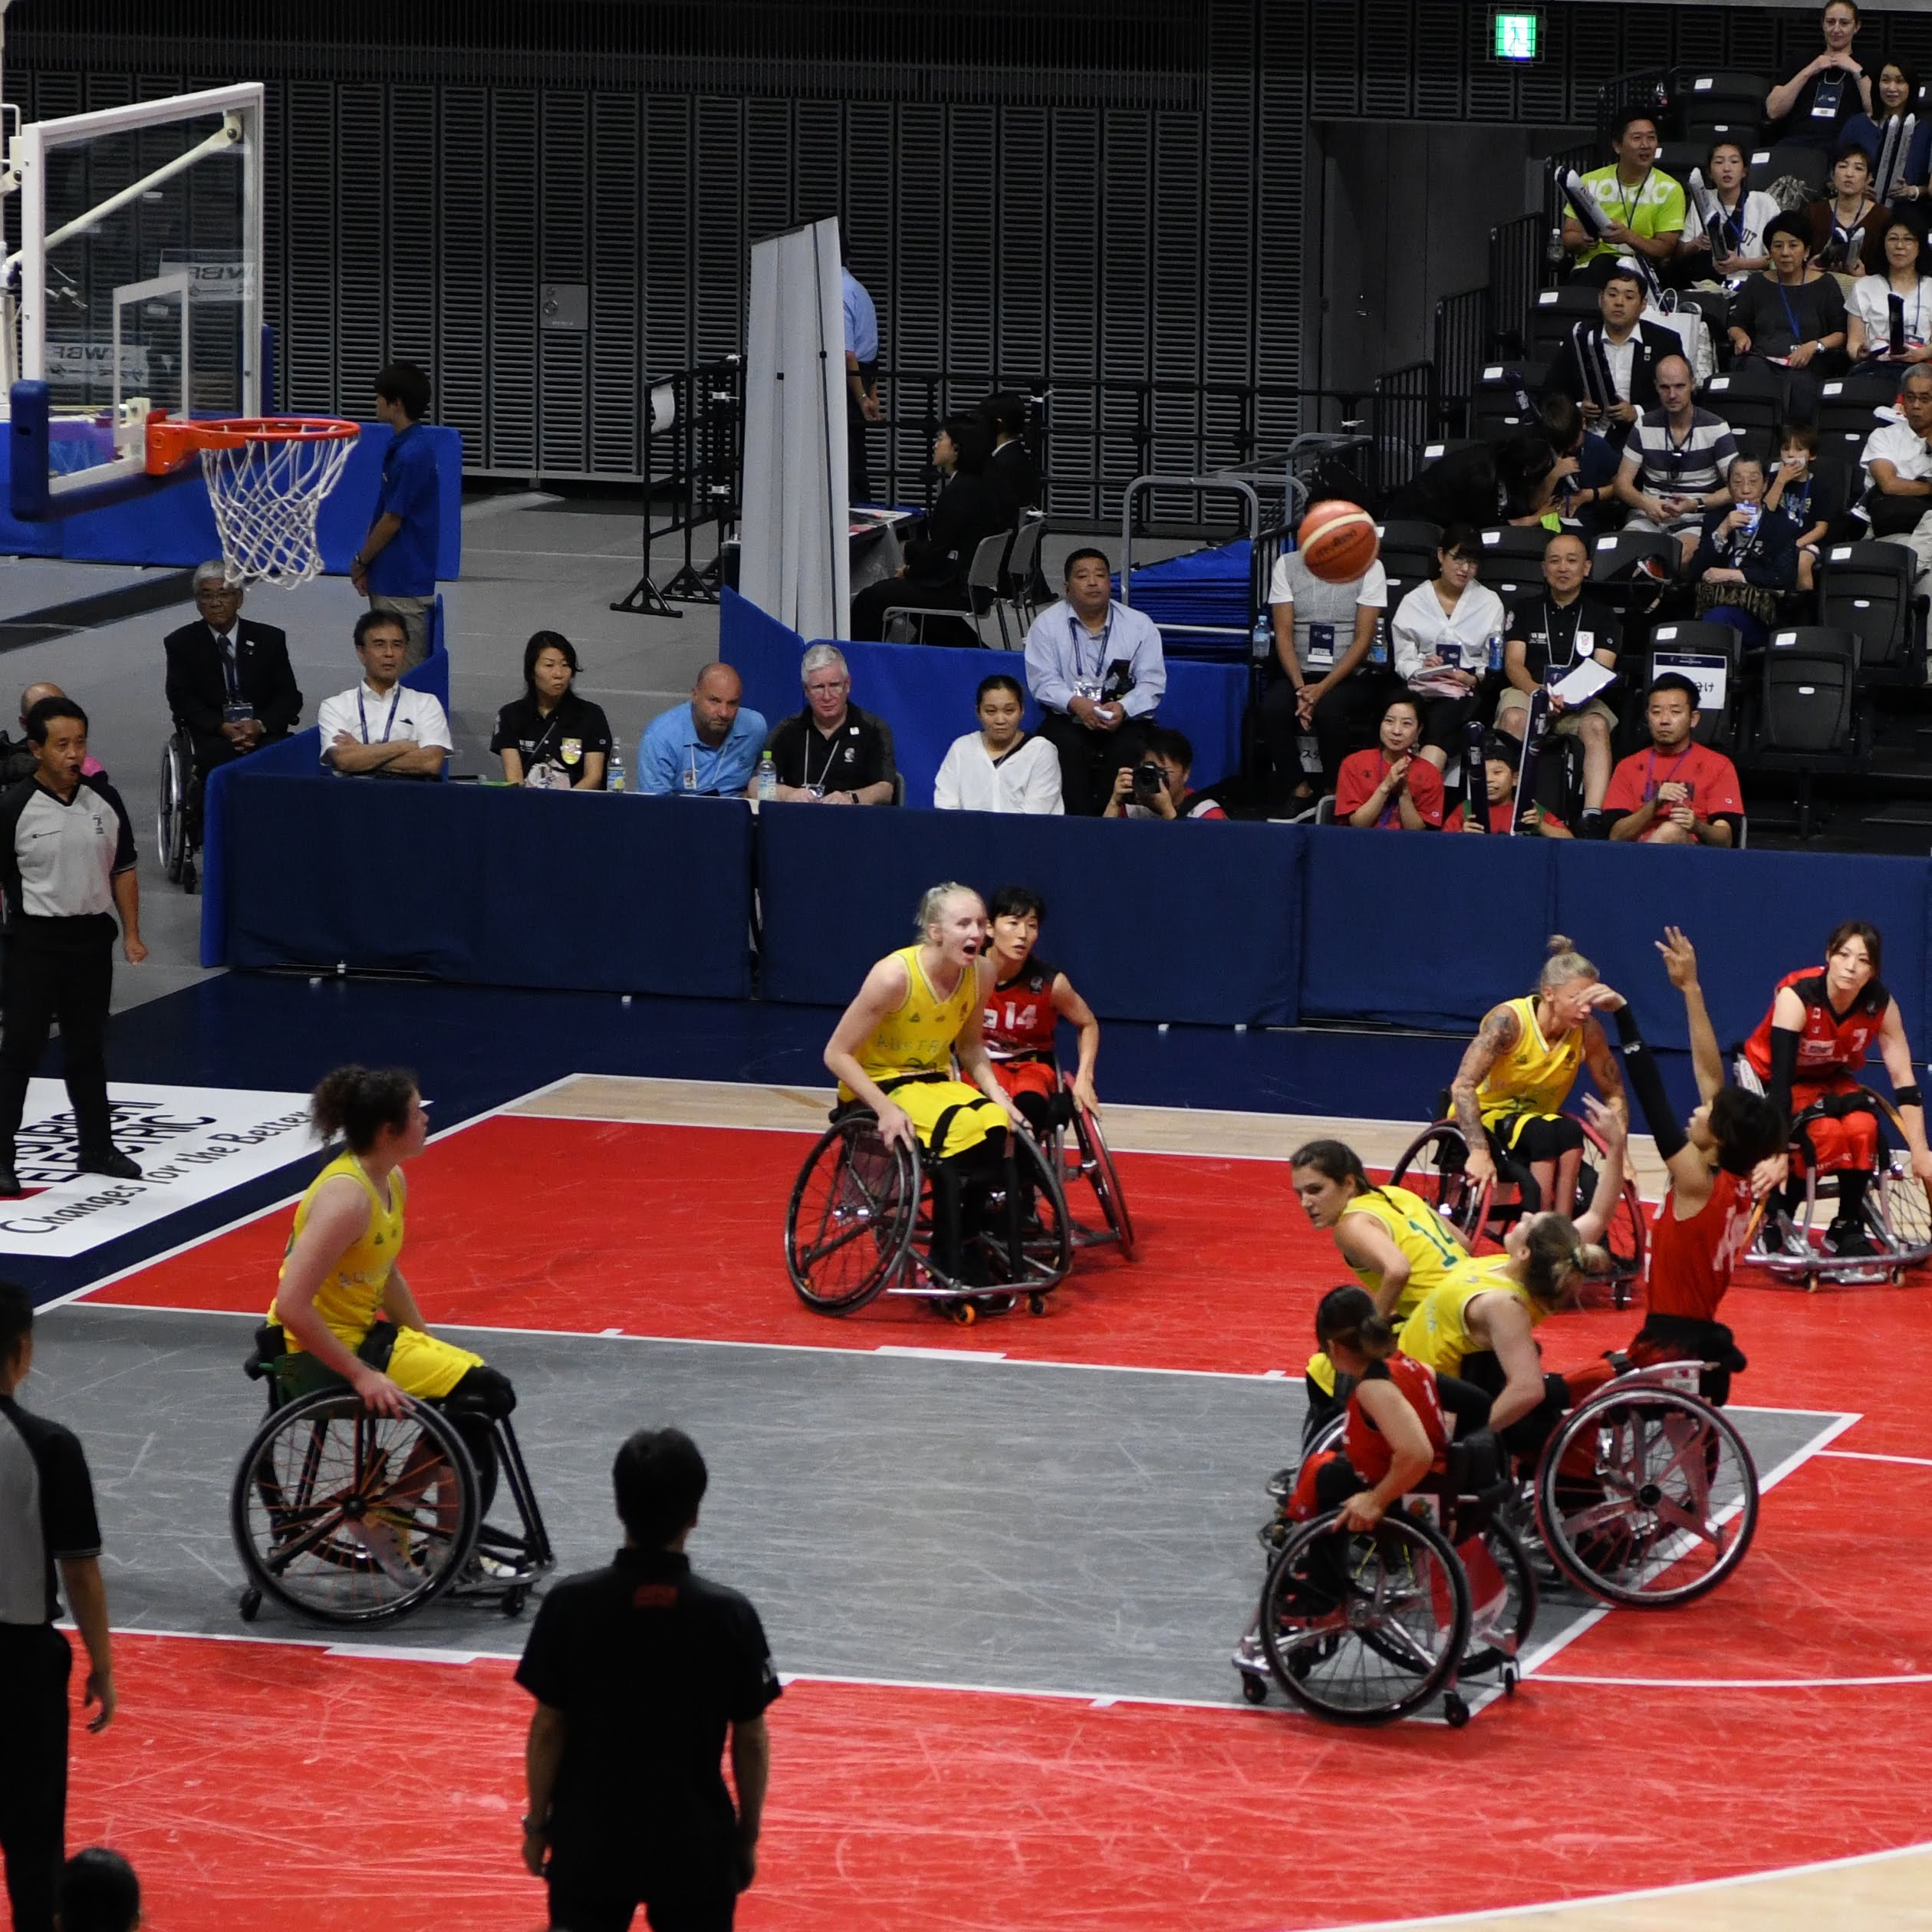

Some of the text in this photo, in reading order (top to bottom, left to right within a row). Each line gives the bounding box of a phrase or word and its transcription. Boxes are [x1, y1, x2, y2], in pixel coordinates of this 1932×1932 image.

[1004, 1001, 1037, 1030] 14
[1851, 1028, 1868, 1052] 7
[206, 1111, 313, 1144] Better
[173, 1146, 241, 1163] the
[0, 1184, 148, 1234] Changes
